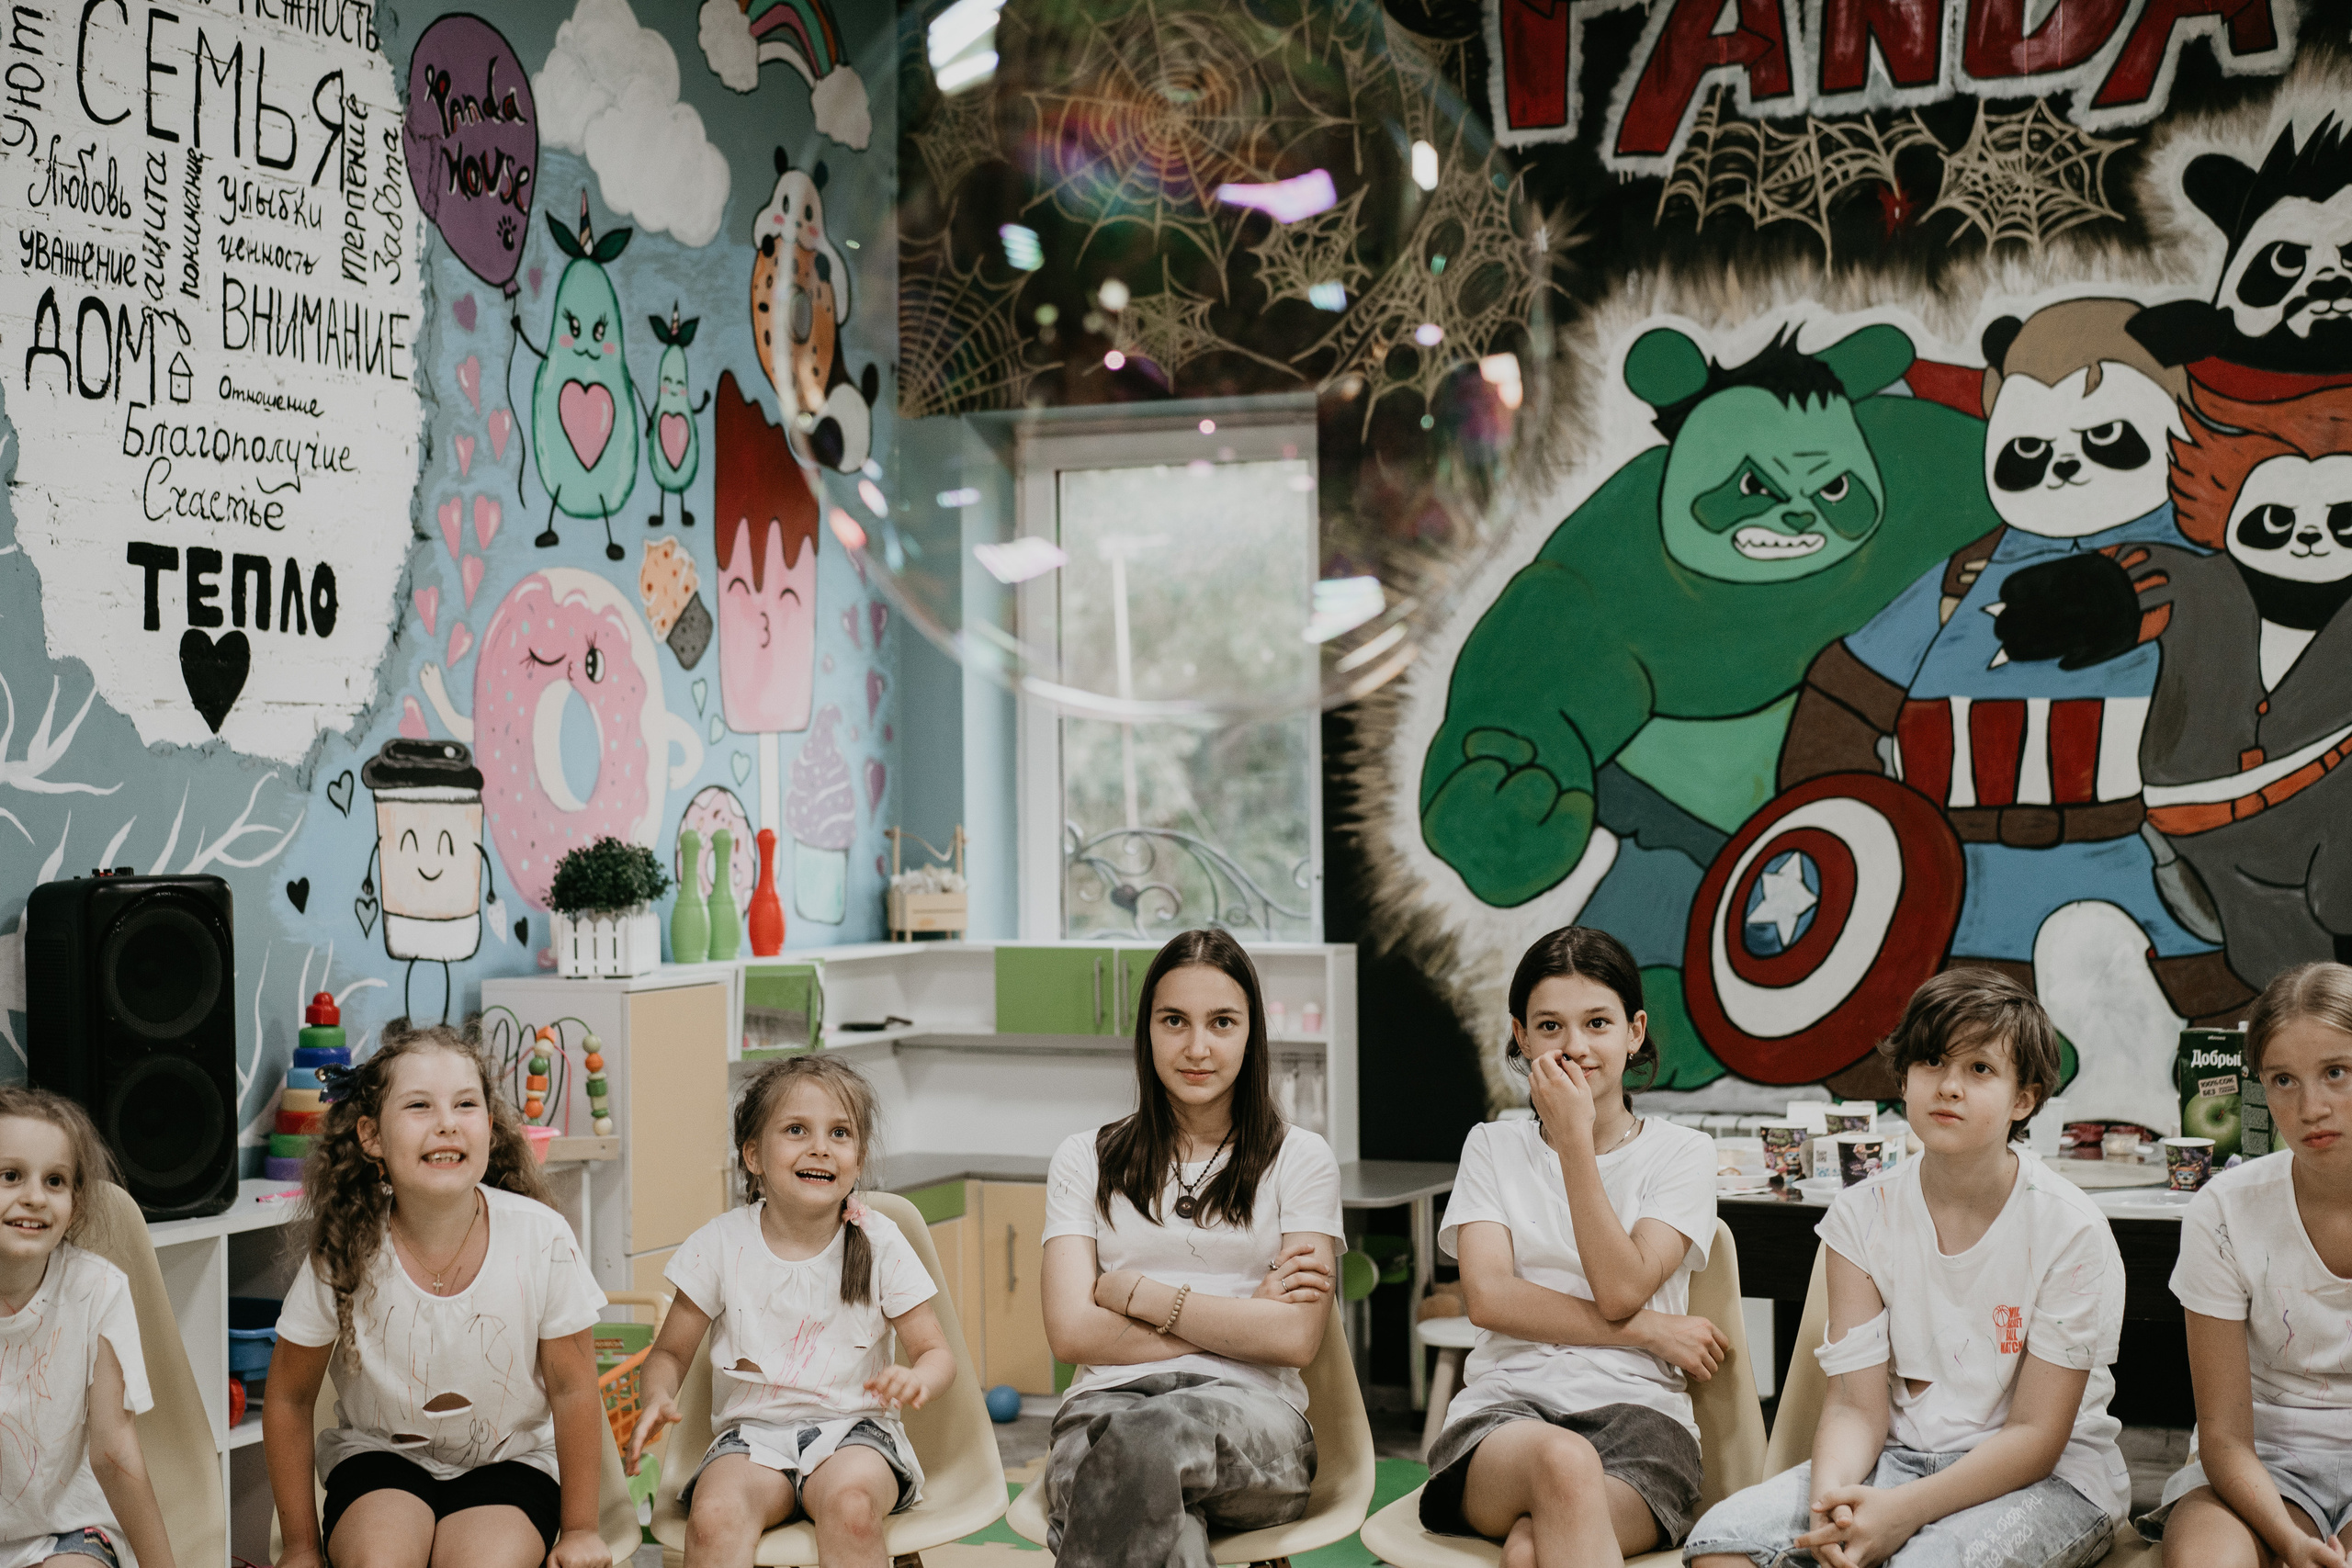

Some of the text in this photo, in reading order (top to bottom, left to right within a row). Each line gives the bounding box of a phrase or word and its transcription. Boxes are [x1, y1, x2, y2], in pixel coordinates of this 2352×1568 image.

[76, 0, 345, 191] СЕМЬЯ
[424, 56, 527, 139] Panda
[28, 134, 131, 219] Любовь
[373, 127, 404, 285] Забота
[218, 234, 322, 276] ценность
[26, 286, 155, 405] ДОМ
[222, 273, 411, 381] ВНИМАНИЕ
[220, 376, 324, 417] Отношение
[123, 401, 359, 493] Благополучие
[143, 457, 286, 530] Счастье
[128, 542, 338, 637] ТЕПЛО
